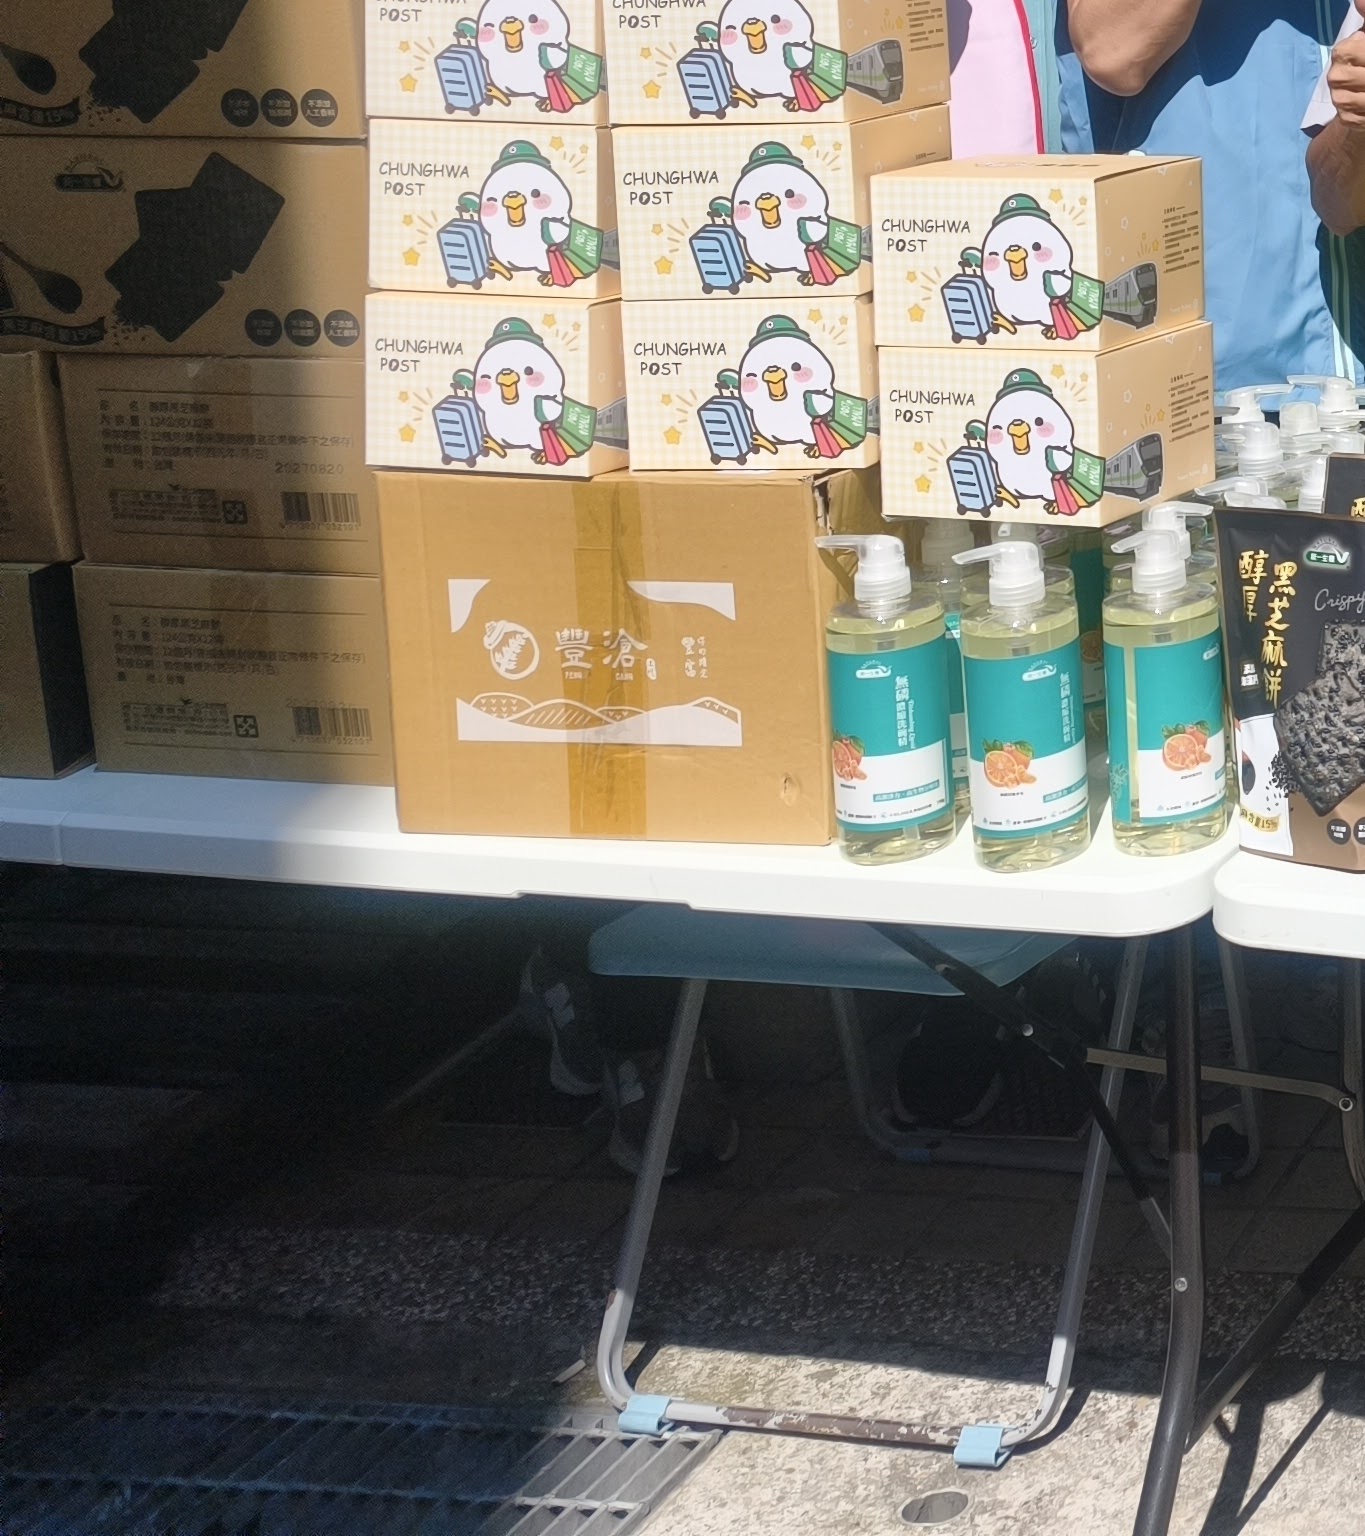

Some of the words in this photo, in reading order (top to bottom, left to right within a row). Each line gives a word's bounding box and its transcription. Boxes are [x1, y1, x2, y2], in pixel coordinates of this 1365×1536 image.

[382, 8, 421, 21] POST
[620, 15, 660, 28] POST
[381, 163, 468, 177] CHUNGHWA
[624, 171, 718, 185] CHUNGHWA
[386, 182, 424, 195] POST
[630, 192, 672, 205] POST
[882, 219, 970, 233] CHUNGHWA
[888, 238, 926, 252] POST
[377, 338, 463, 353] CHUNGHWA
[634, 343, 726, 356] CHUNGHWA
[381, 358, 419, 372] POST
[641, 362, 681, 375] POST
[890, 390, 974, 405] CHUNGHWA
[896, 409, 933, 423] POST
[1240, 550, 1268, 622] 醇厚
[1261, 562, 1298, 708] 黑芝麻餅
[555, 628, 648, 670] 豐滄
